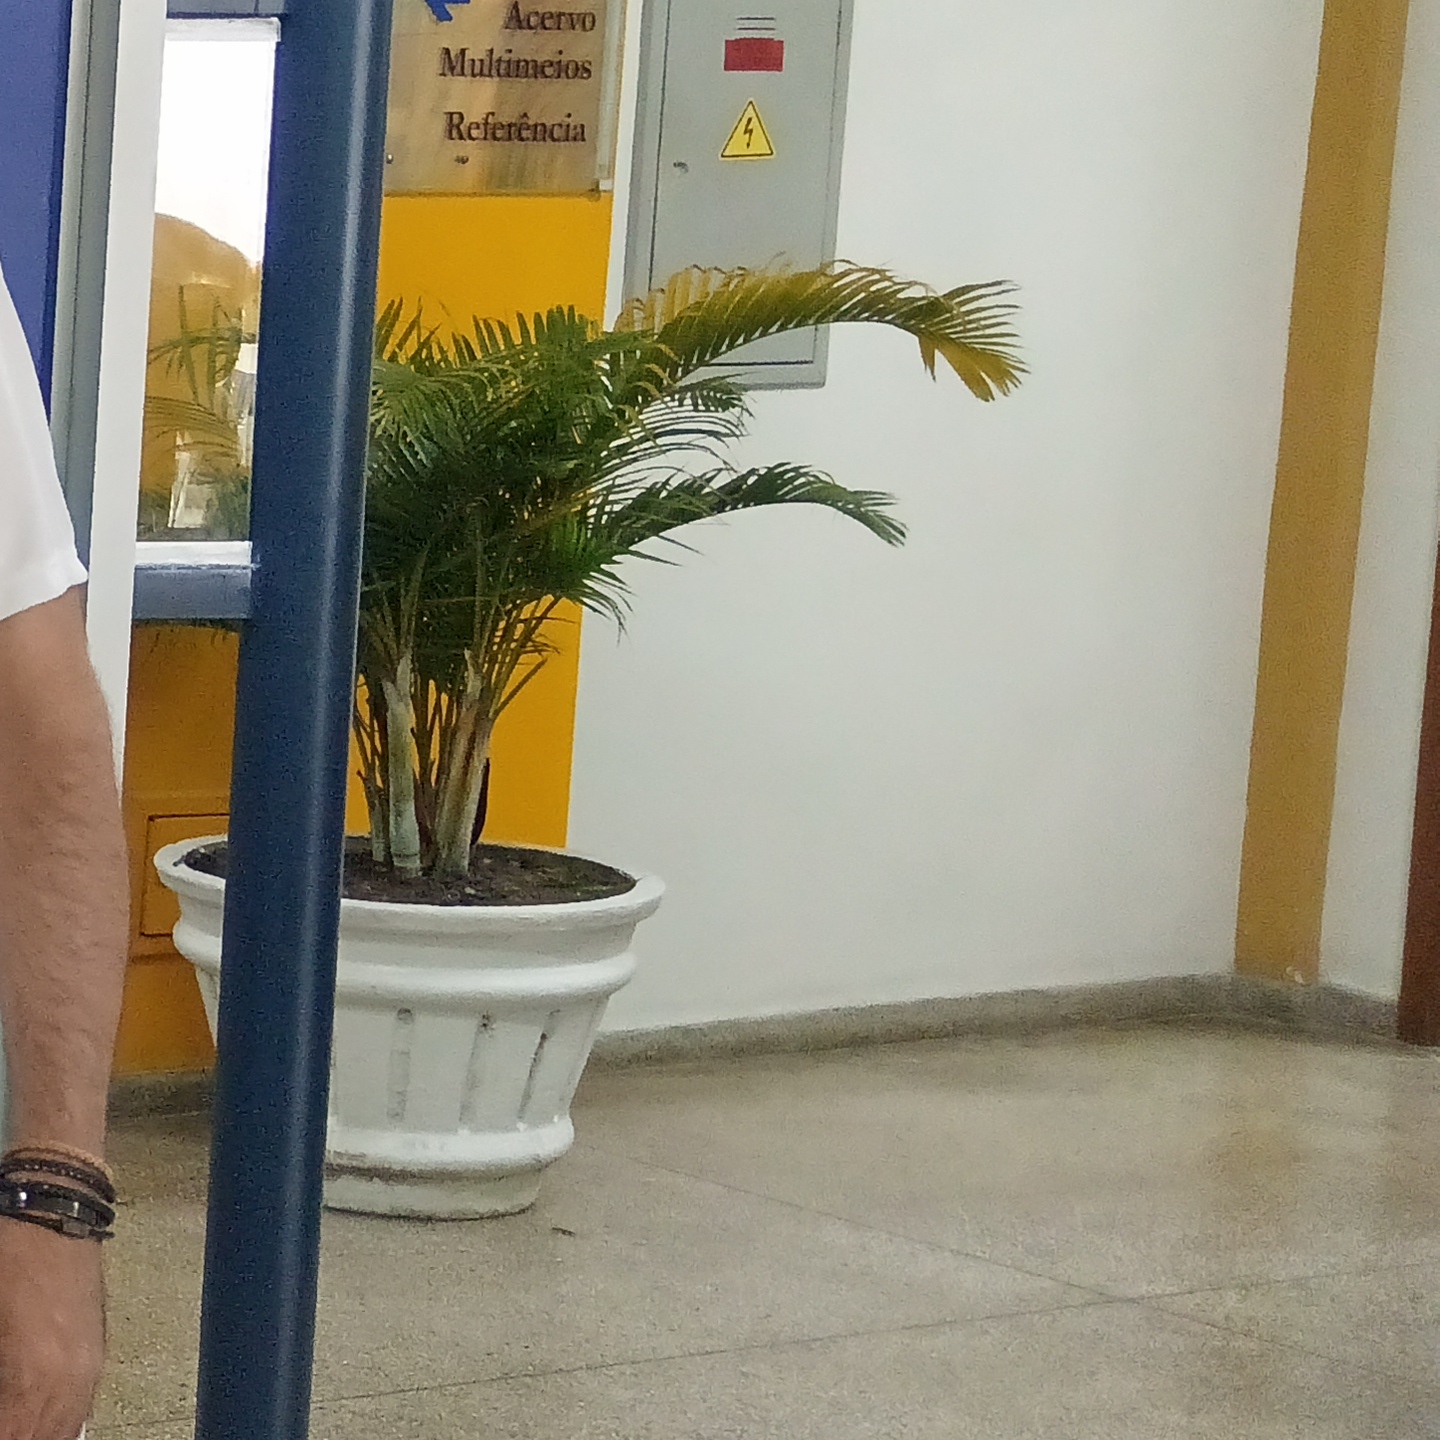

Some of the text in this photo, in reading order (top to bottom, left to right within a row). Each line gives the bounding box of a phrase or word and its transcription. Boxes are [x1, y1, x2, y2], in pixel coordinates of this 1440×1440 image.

[504, 0, 597, 33] Acervo
[438, 46, 593, 82] Multimeios
[442, 110, 588, 144] Referência
